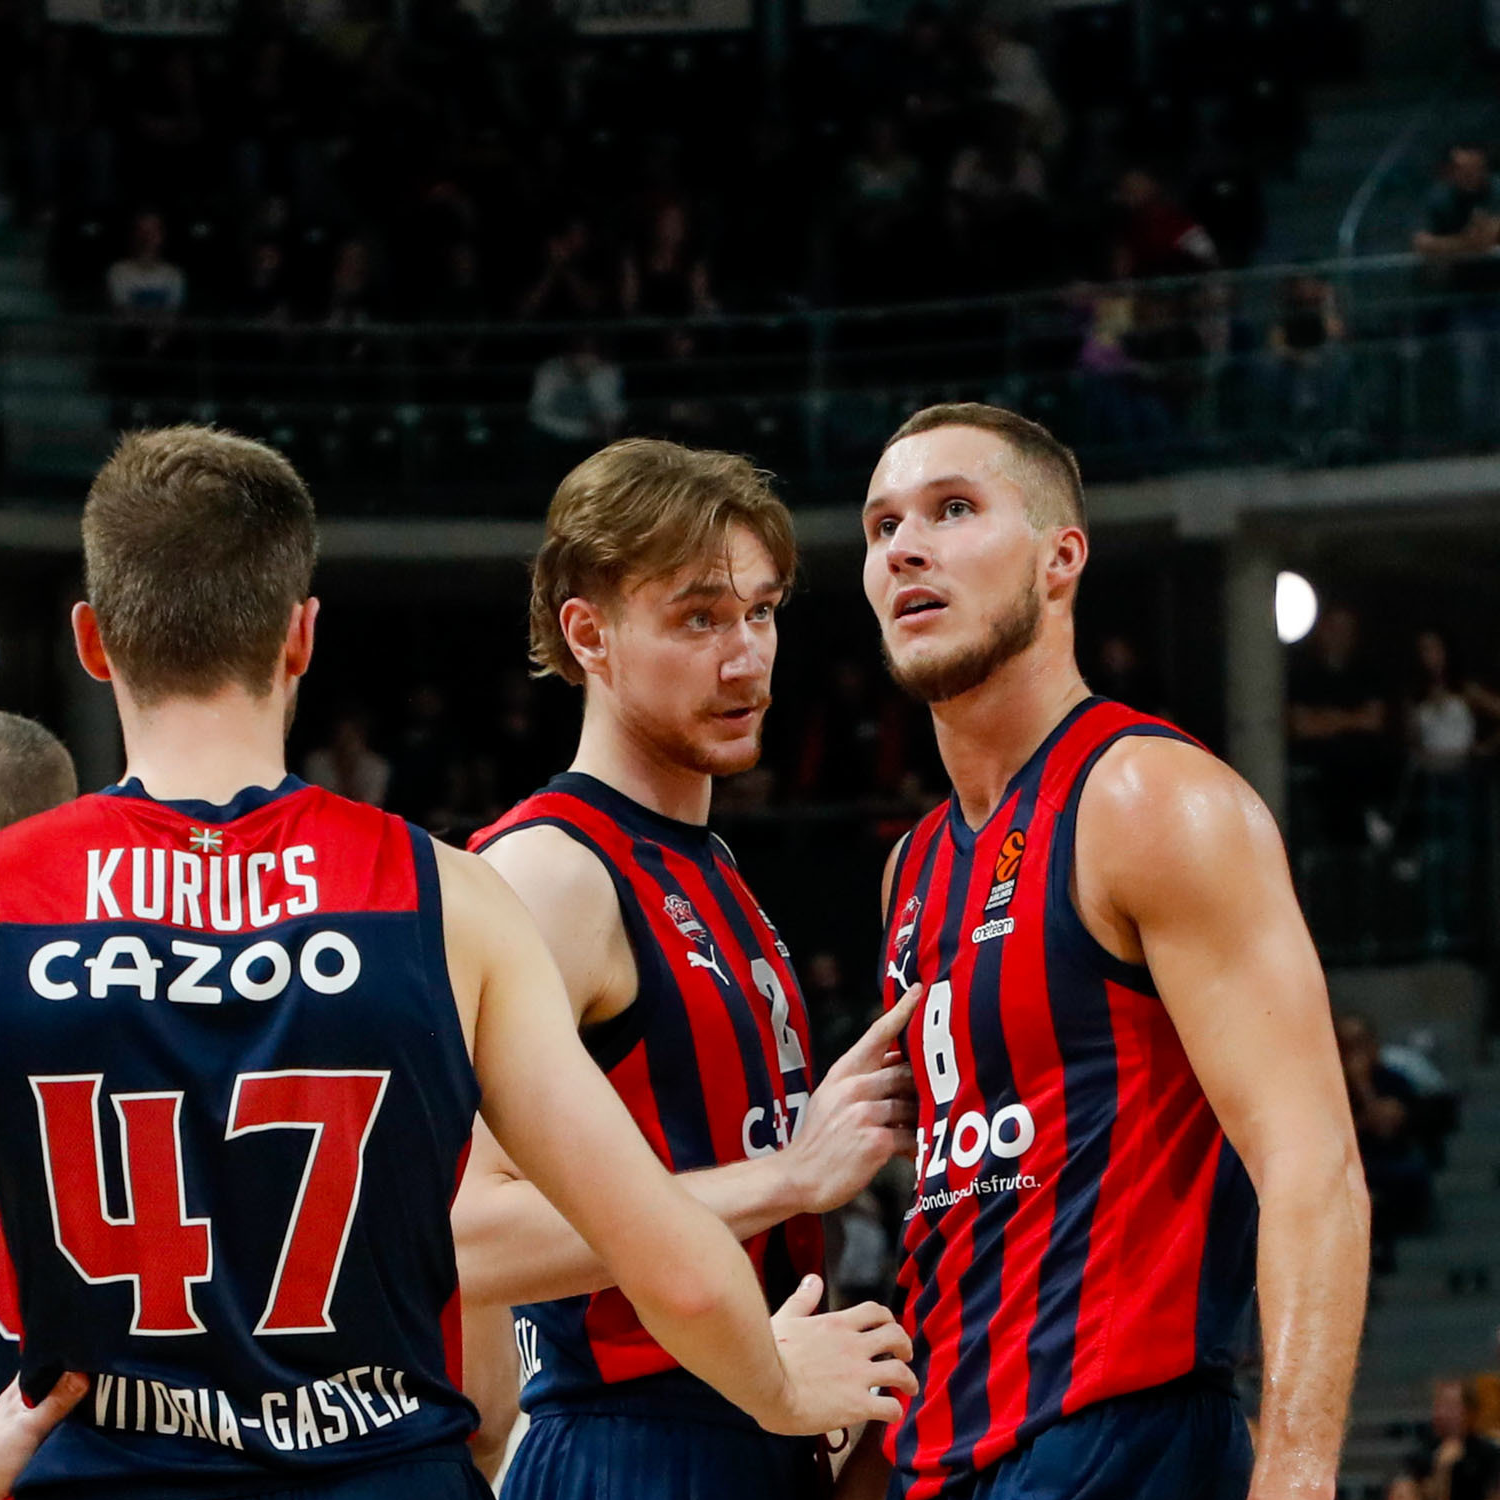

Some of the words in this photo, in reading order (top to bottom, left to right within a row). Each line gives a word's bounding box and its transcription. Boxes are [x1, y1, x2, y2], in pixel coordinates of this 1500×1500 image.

[85, 844, 320, 932] KURUCS
[27, 931, 362, 1005] CAZOO
[750, 957, 807, 1074] 2
[922, 980, 959, 1105] 8
[27, 1069, 392, 1337] 47
